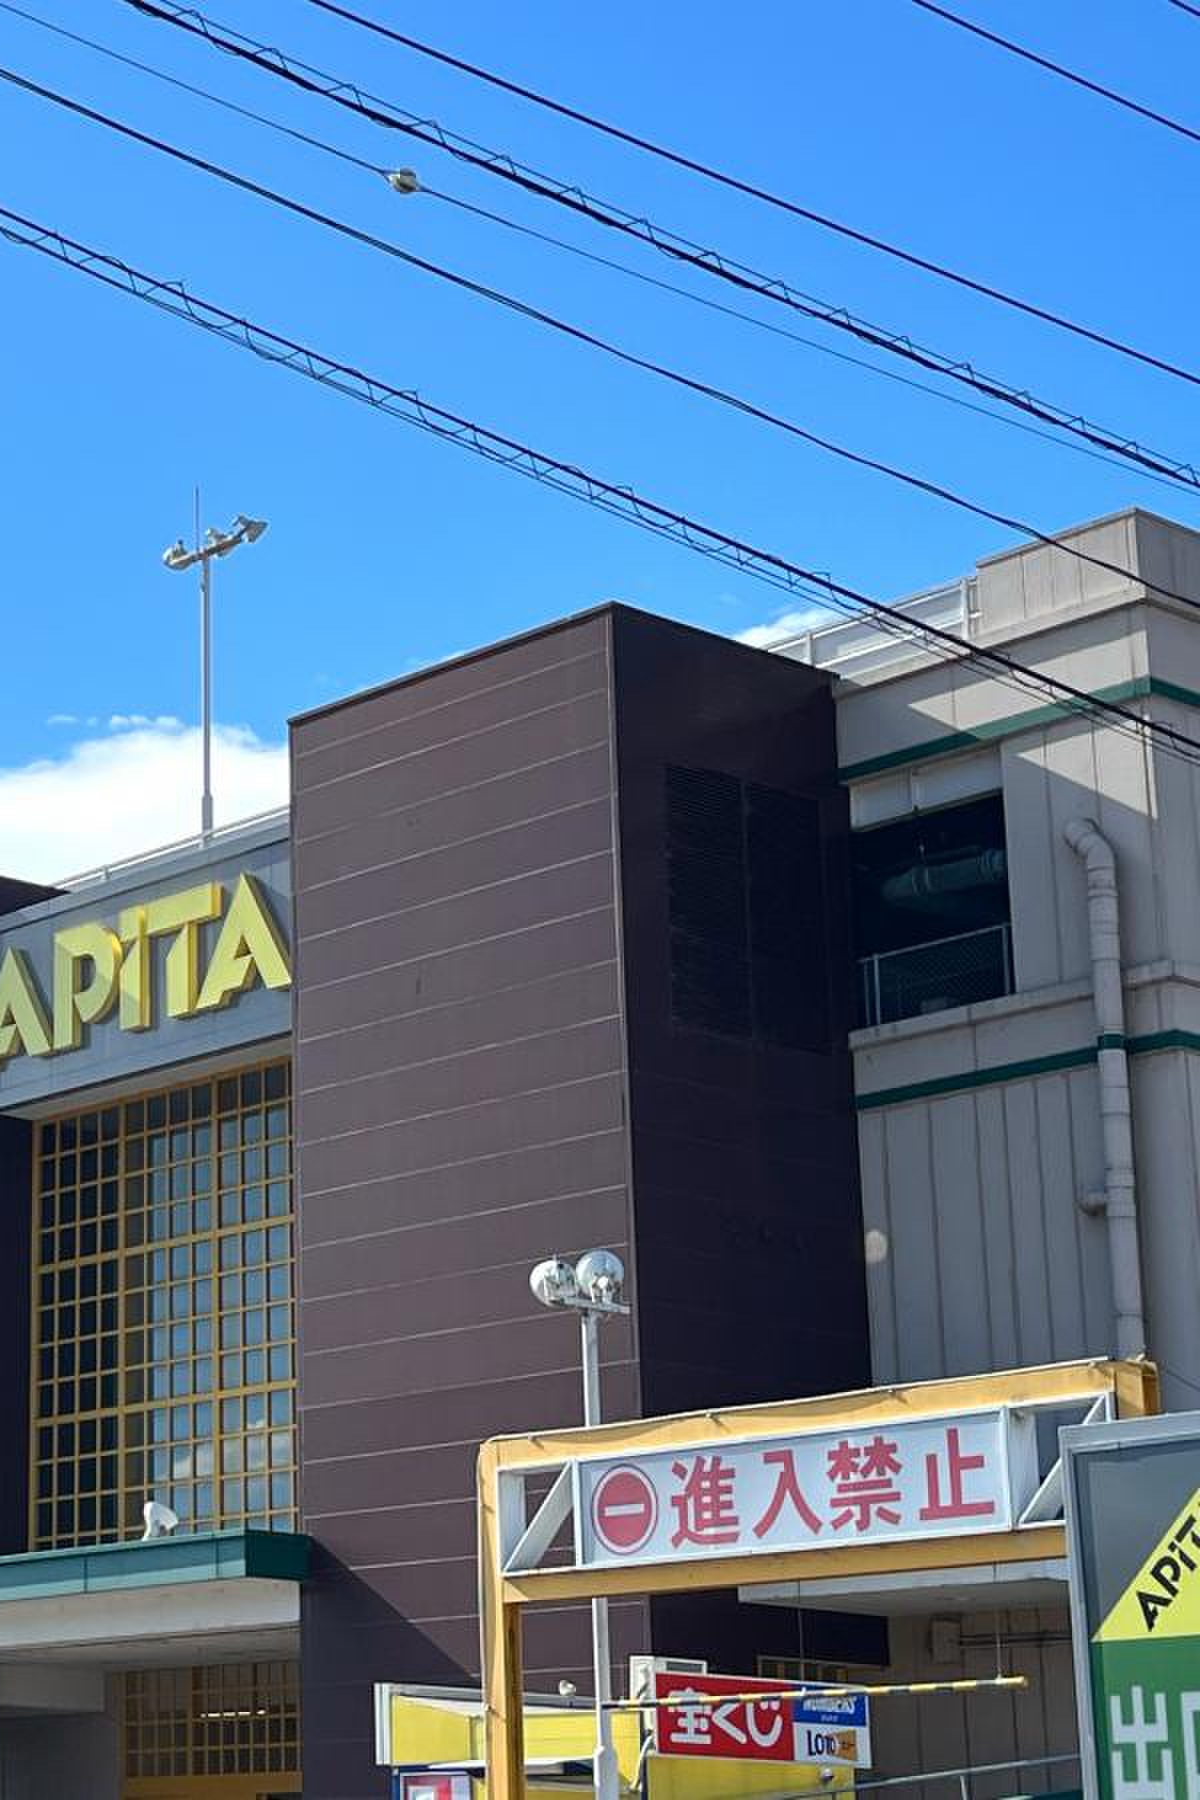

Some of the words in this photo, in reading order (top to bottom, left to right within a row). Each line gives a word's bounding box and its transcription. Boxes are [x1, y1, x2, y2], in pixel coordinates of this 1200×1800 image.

[670, 1427, 996, 1549] 進入禁止
[1136, 1501, 1200, 1632] APIT
[668, 1687, 783, 1747] 宝くじ
[1109, 1685, 1200, 1800] 出
